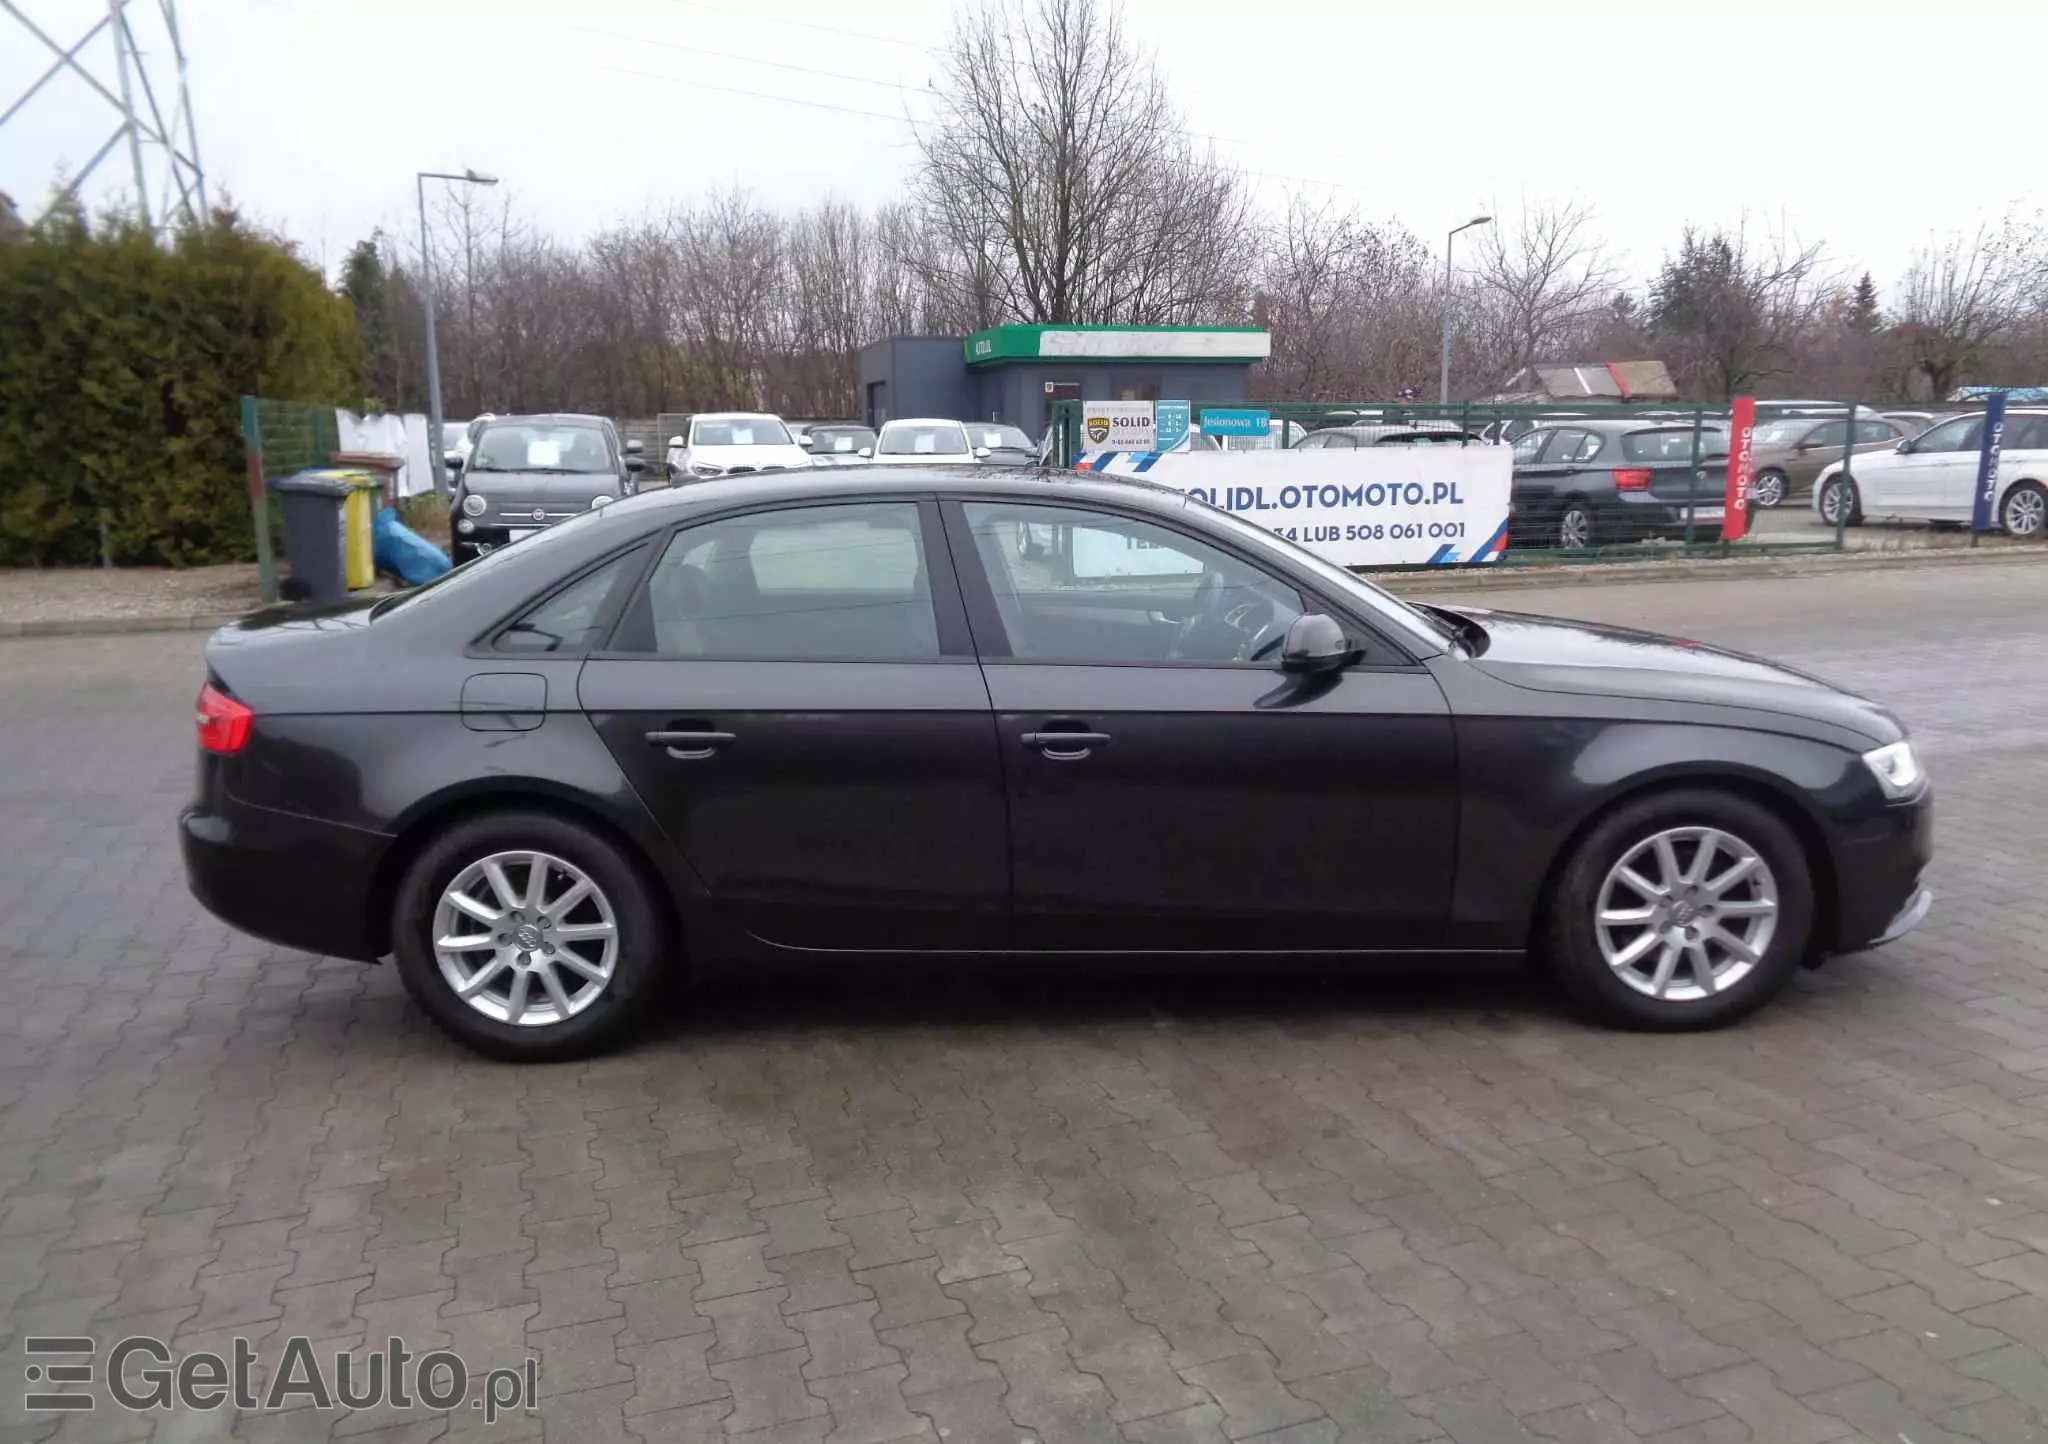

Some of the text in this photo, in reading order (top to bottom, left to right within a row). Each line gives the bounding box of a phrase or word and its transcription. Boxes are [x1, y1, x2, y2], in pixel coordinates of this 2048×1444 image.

[1112, 416, 1150, 428] SOLID
[1733, 426, 1752, 510] OTOMOTO
[1179, 482, 1465, 512] OLIDL.OTOMOTO.PL
[1304, 527, 1340, 543] LUB
[1346, 524, 1385, 542] 508
[1389, 523, 1424, 540] 061
[1428, 522, 1466, 538] 001
